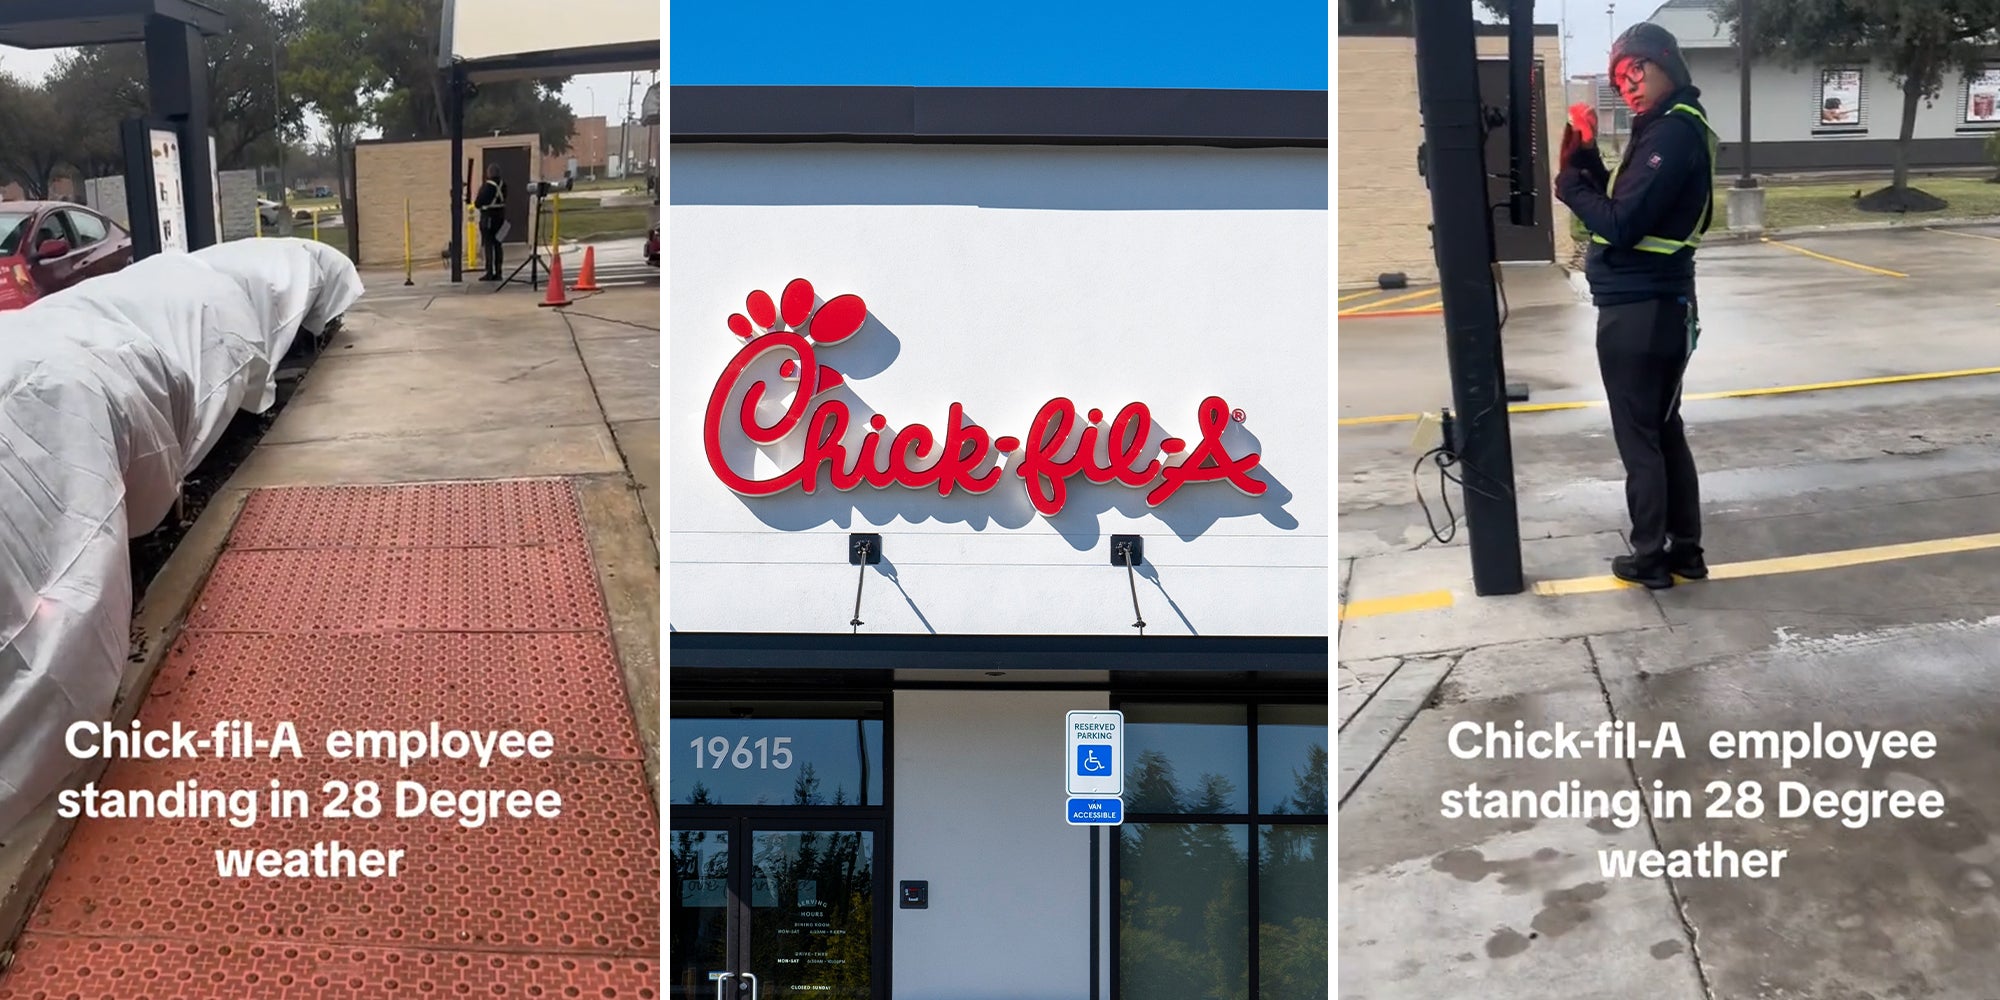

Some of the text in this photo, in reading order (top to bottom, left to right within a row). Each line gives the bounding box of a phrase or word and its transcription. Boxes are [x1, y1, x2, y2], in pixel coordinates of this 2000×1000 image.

[1074, 723, 1116, 731] RESERVED
[1077, 732, 1112, 740] PARKING
[690, 736, 793, 770] 19615
[797, 899, 828, 908] SERVING
